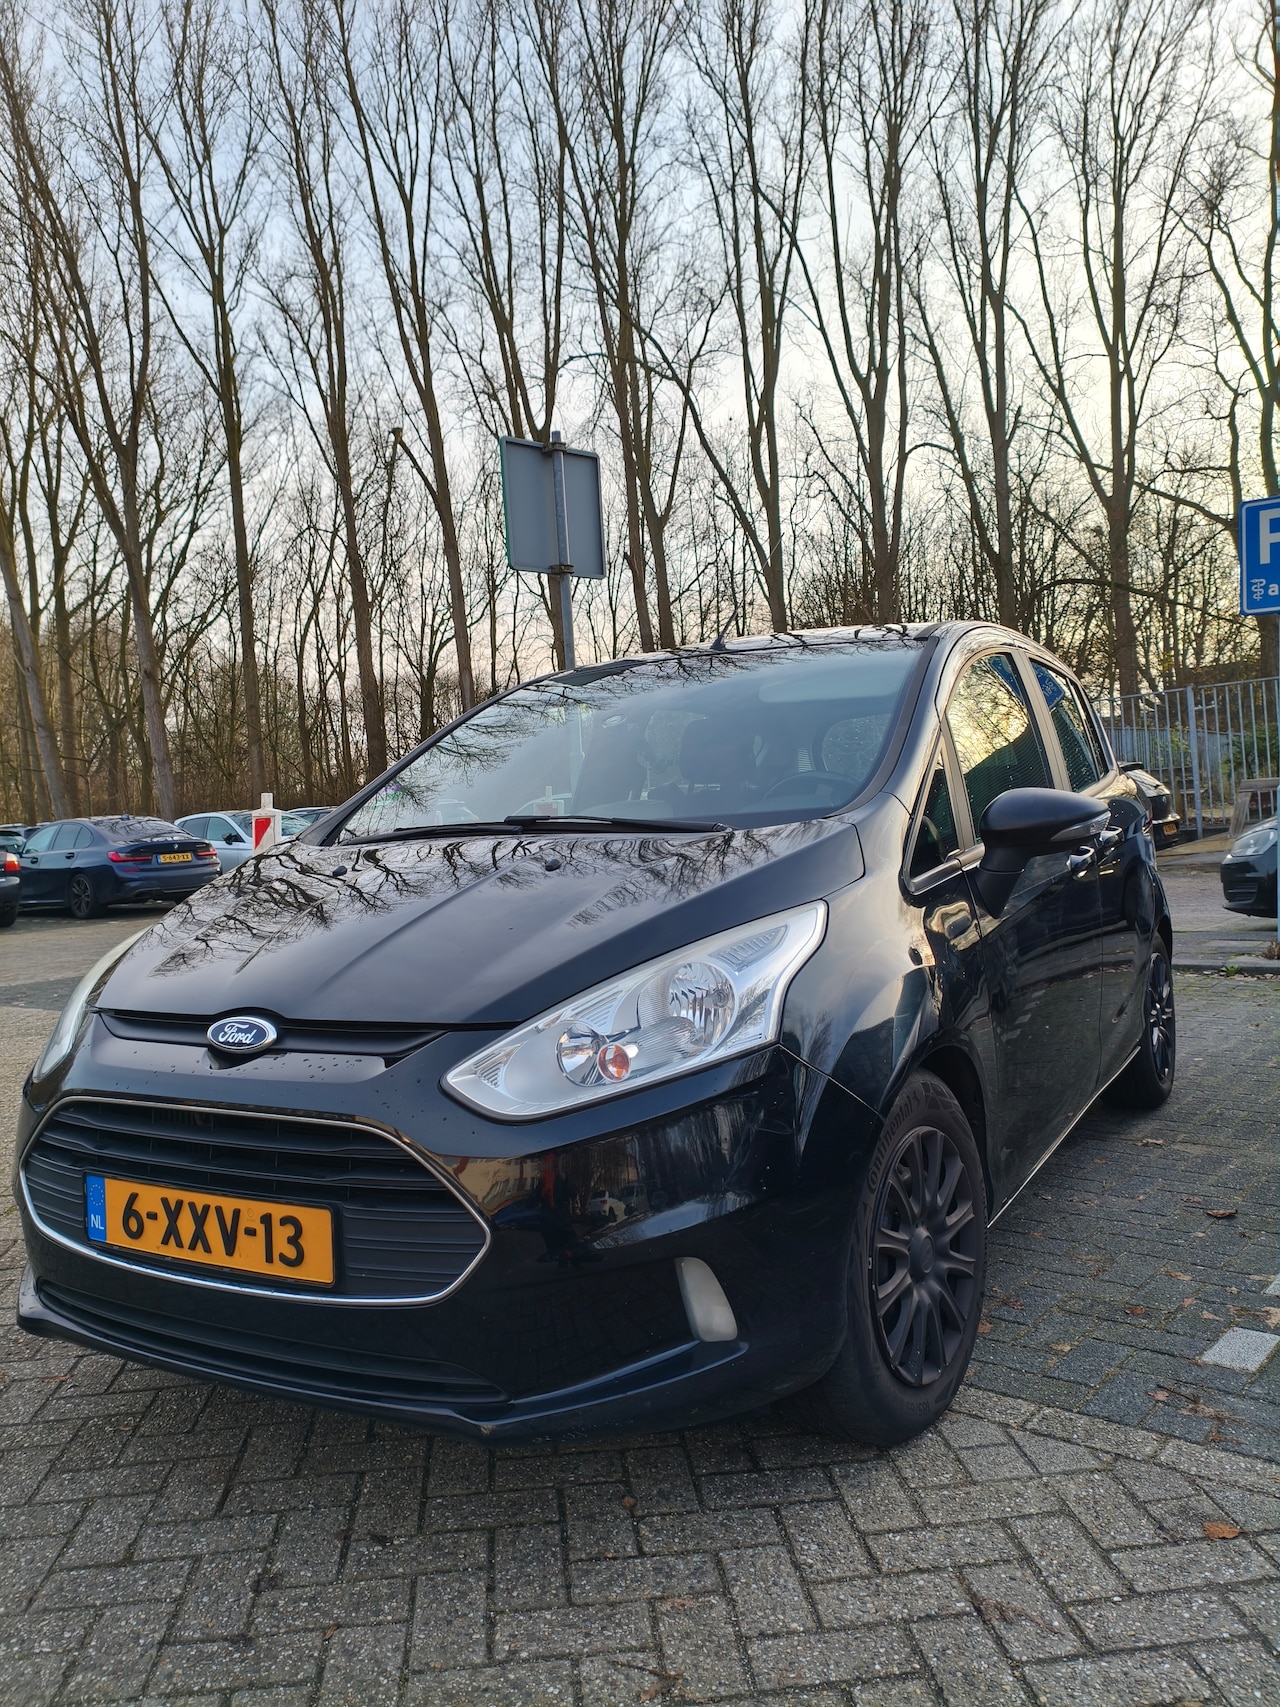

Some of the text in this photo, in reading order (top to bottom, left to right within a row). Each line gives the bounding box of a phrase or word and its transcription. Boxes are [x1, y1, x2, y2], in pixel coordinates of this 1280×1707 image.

[218, 1022, 257, 1044] Ford
[90, 1213, 105, 1230] NL
[122, 1191, 305, 1268] 6-XXV-13
